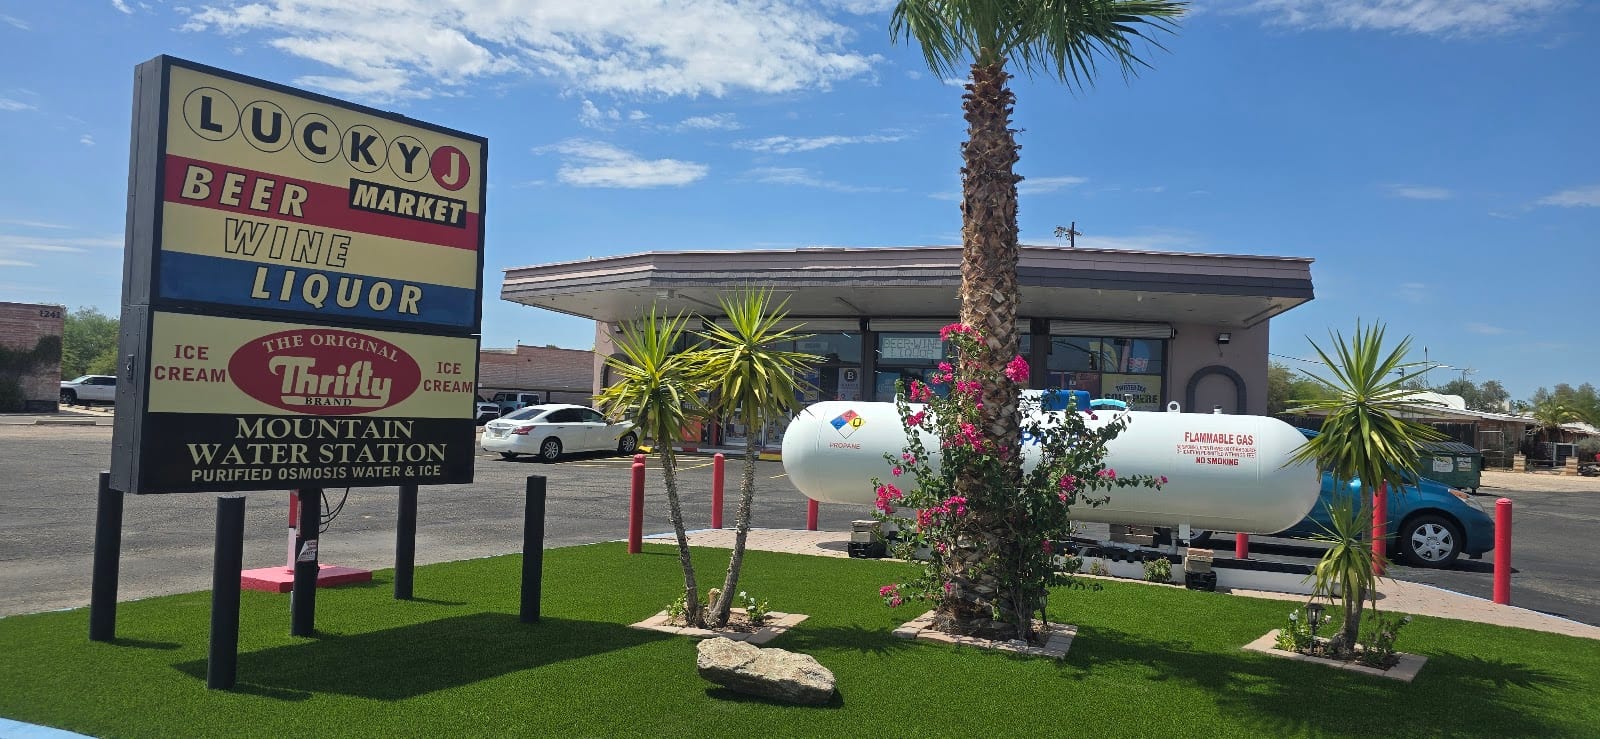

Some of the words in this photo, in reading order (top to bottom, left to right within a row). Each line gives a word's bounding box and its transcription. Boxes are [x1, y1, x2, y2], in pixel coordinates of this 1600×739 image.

[200, 95, 422, 175] LUCKY
[180, 164, 308, 218] BEER
[352, 183, 464, 224] MARKET
[225, 217, 351, 268] WINE
[251, 266, 422, 315] LIQUOR
[173, 345, 209, 360] ICE
[262, 334, 304, 353] THE
[310, 334, 398, 362] ORIGINAL
[154, 365, 226, 383] CREAM
[437, 361, 462, 374] ICE
[268, 355, 392, 408] Thrifty
[423, 379, 473, 393] CREAM
[305, 397, 352, 406] BRAND
[234, 417, 415, 439] MOUNTAIN
[853, 417, 862, 427] 0
[829, 441, 861, 450] PROPANE
[1184, 431, 1234, 445] FLAMMABLE
[1236, 434, 1254, 446] GAS
[187, 443, 311, 465] WATER
[318, 443, 448, 463] STATION
[1195, 456, 1206, 464] NO
[1207, 457, 1239, 466] SMOKING
[191, 468, 272, 482] PURIFIED
[278, 467, 347, 480] OSMOSIS
[352, 465, 401, 478] WATER
[405, 465, 415, 477] &
[419, 465, 441, 476] ICE
